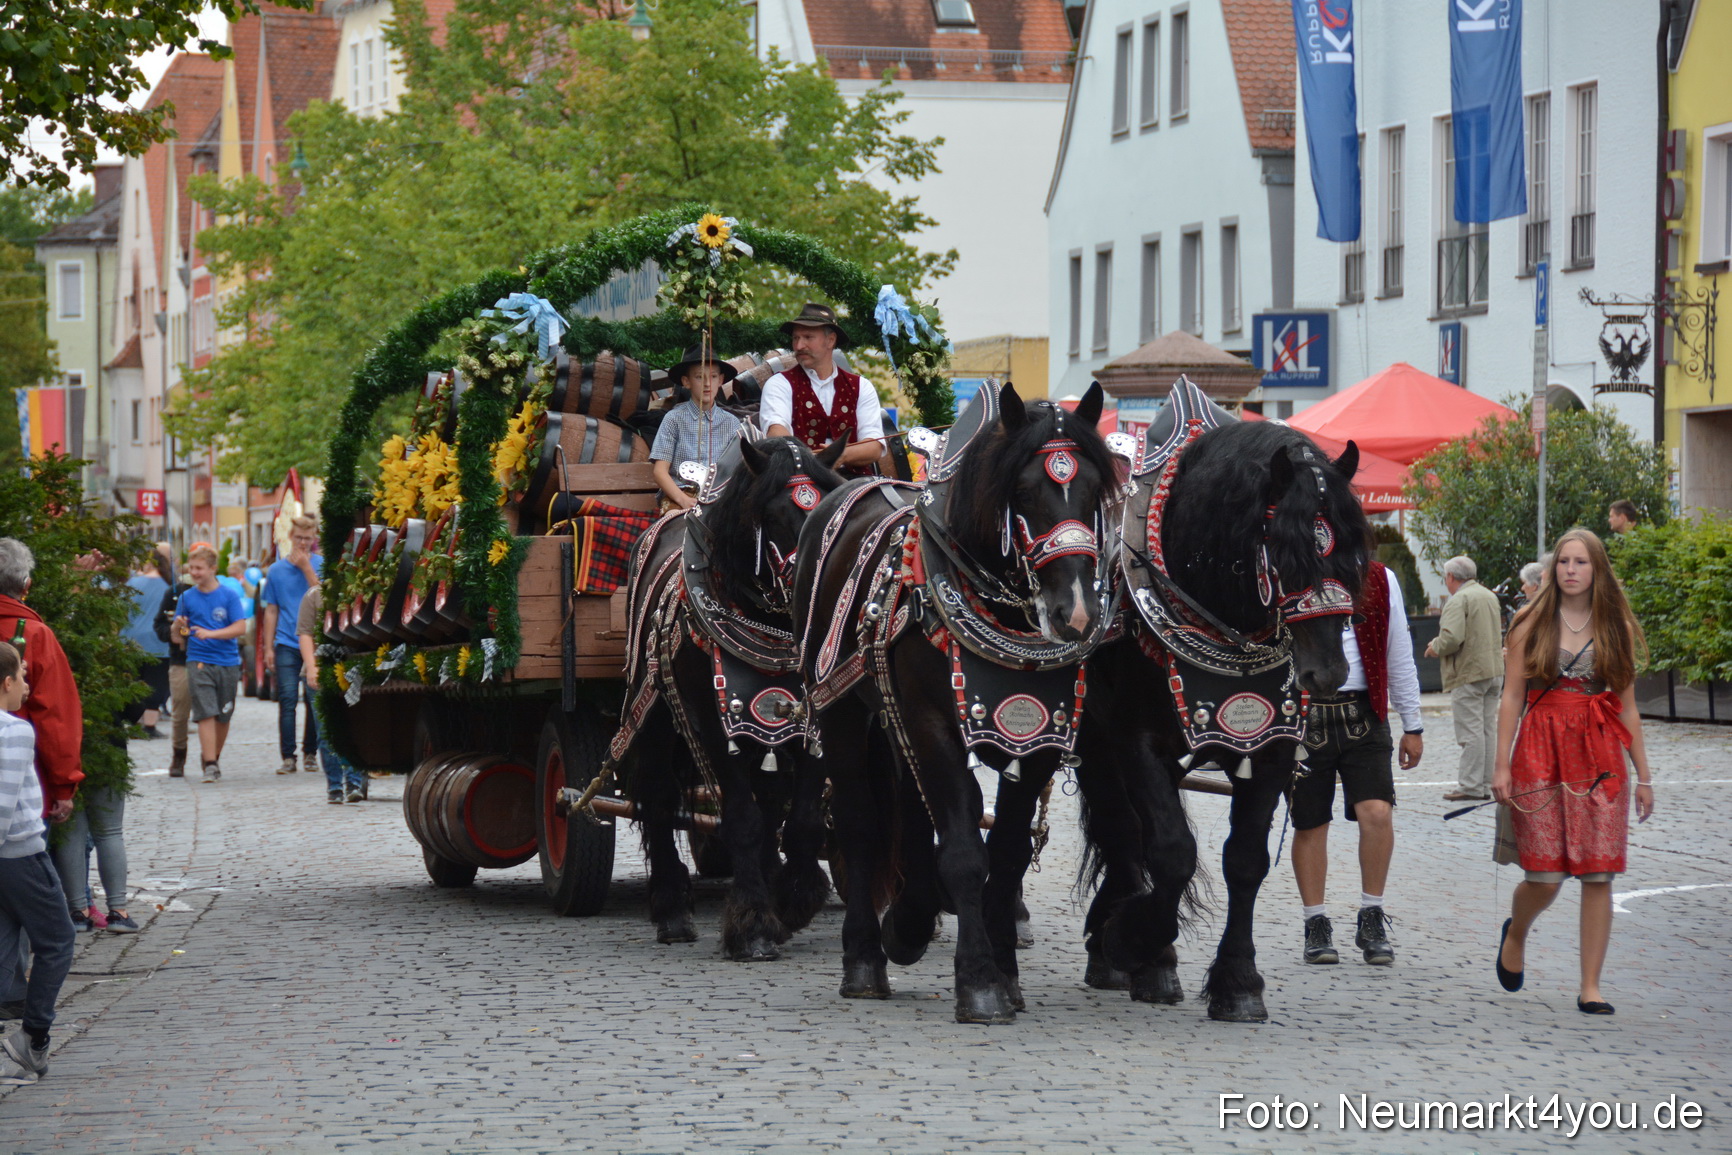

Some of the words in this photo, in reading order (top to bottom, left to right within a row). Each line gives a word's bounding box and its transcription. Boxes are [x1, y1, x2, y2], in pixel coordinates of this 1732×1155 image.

[1660, 129, 1687, 367] HOTEL
[1263, 320, 1321, 373] K&L
[1281, 372, 1320, 380] RUPPERT
[142, 491, 160, 513] T
